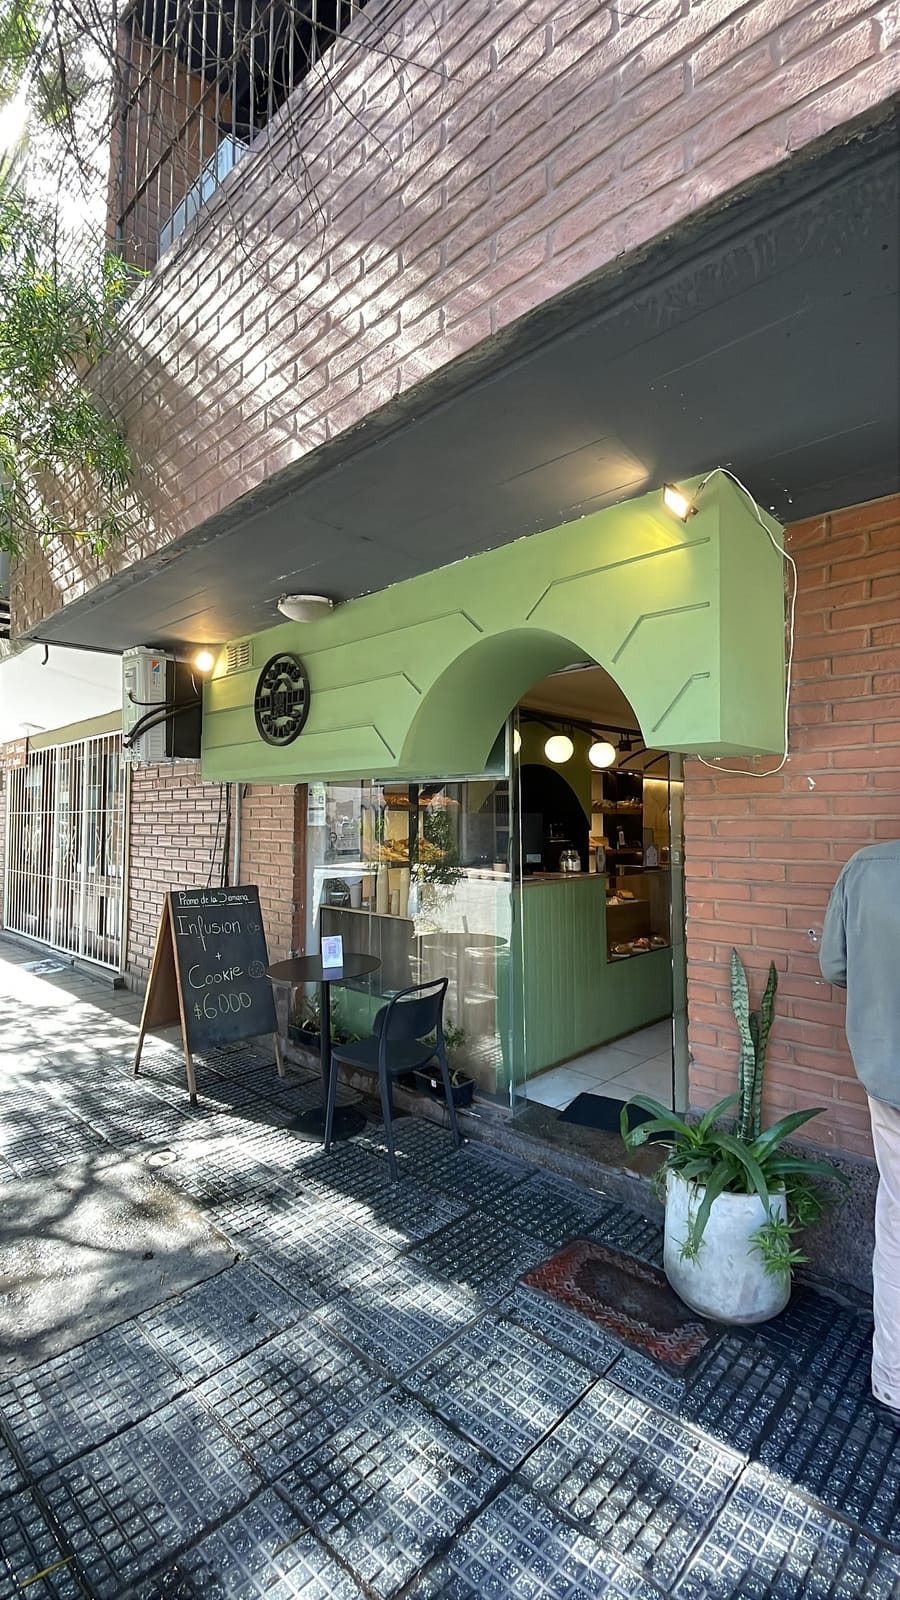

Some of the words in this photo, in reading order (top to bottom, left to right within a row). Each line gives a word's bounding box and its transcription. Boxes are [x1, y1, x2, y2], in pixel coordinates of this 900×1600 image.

[178, 892, 199, 905] Promo
[201, 893, 209, 904] de
[210, 895, 218, 903] la
[177, 915, 241, 952] Infusion
[215, 952, 222, 960] +
[188, 964, 244, 989] Cookie
[194, 992, 252, 1020] $6000
